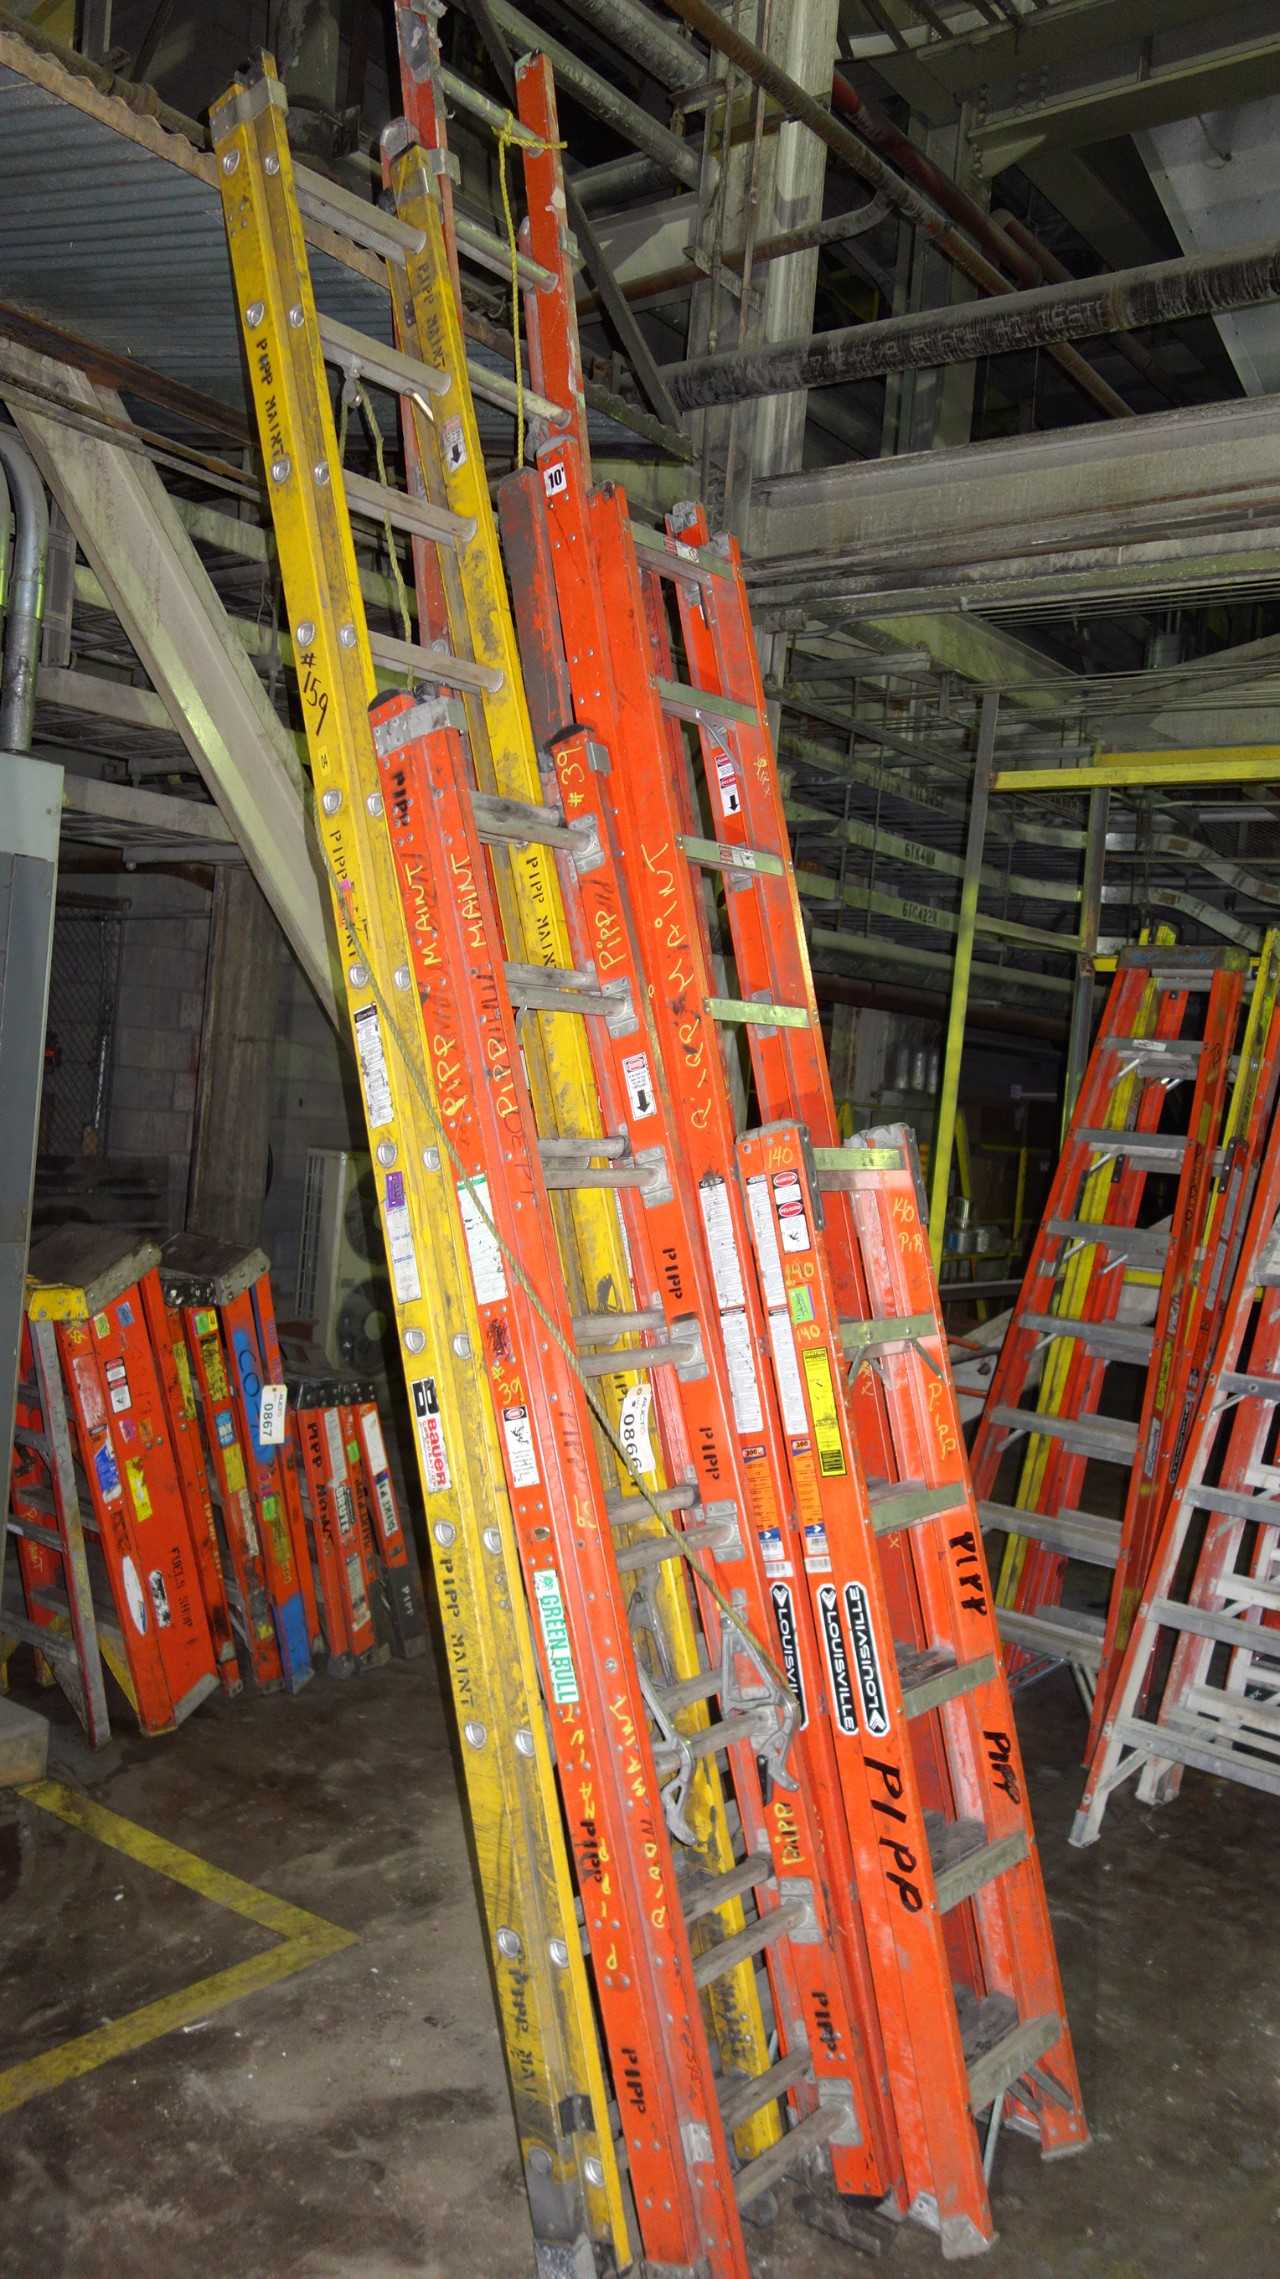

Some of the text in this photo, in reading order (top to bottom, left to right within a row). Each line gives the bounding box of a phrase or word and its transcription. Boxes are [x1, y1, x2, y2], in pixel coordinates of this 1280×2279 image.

[662, 1247, 684, 1300] PIPP
[262, 1402, 273, 1445] 0867
[699, 1427, 721, 1481] PIPP
[440, 1557, 460, 1617] PIPP
[540, 1594, 577, 1701] GREEN BULL
[826, 1611, 855, 1729] LOUISVILLE
[849, 1586, 879, 1708] LOUISVILLE
[864, 1755, 923, 1914] PIPP
[621, 2047, 646, 2115] PIPP
